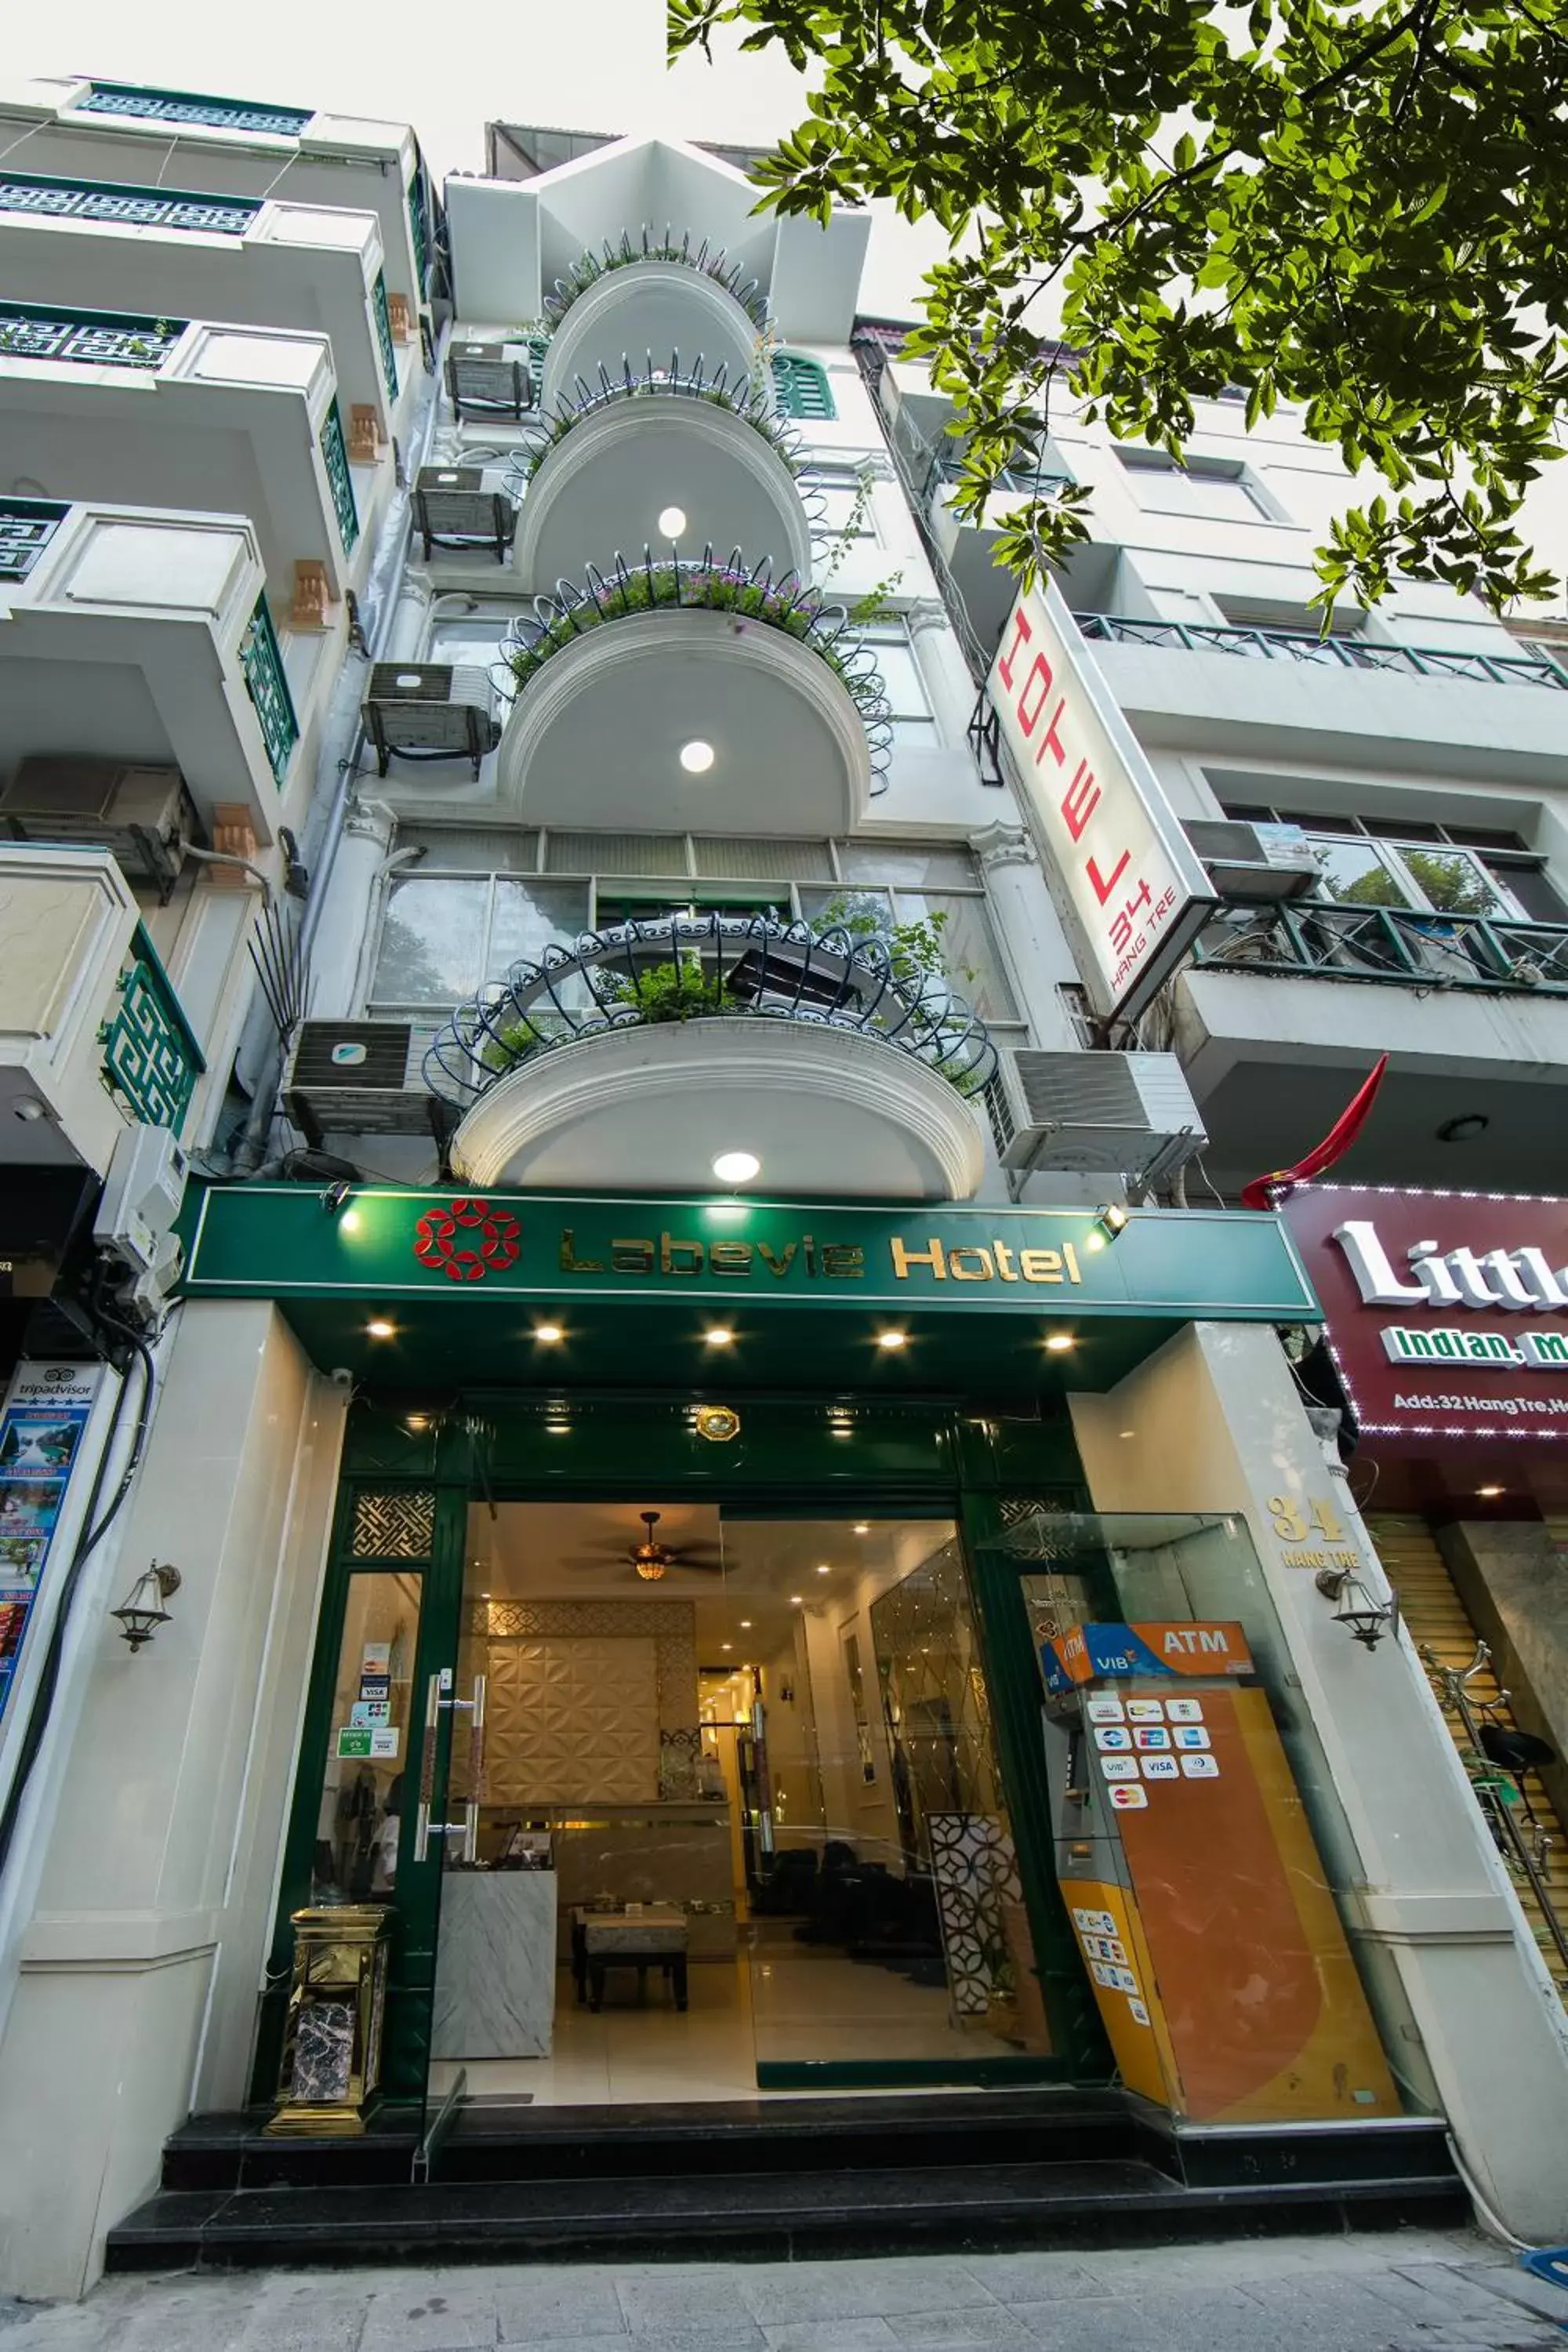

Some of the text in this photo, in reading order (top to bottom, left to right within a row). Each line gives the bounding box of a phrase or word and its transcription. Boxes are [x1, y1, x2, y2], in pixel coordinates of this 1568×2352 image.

[998, 607, 1131, 907] HOTEL
[1109, 878, 1152, 956] 34
[1146, 885, 1177, 931] TRE
[560, 1228, 1082, 1284] Labevie Hotel
[1333, 1220, 1568, 1311] Littl
[19, 1383, 91, 1396] tripadvisor
[1265, 1495, 1346, 1542] 34
[1096, 1657, 1129, 1670] VIB
[1163, 1630, 1229, 1653] ATM
[1149, 1762, 1174, 1771] VISA
